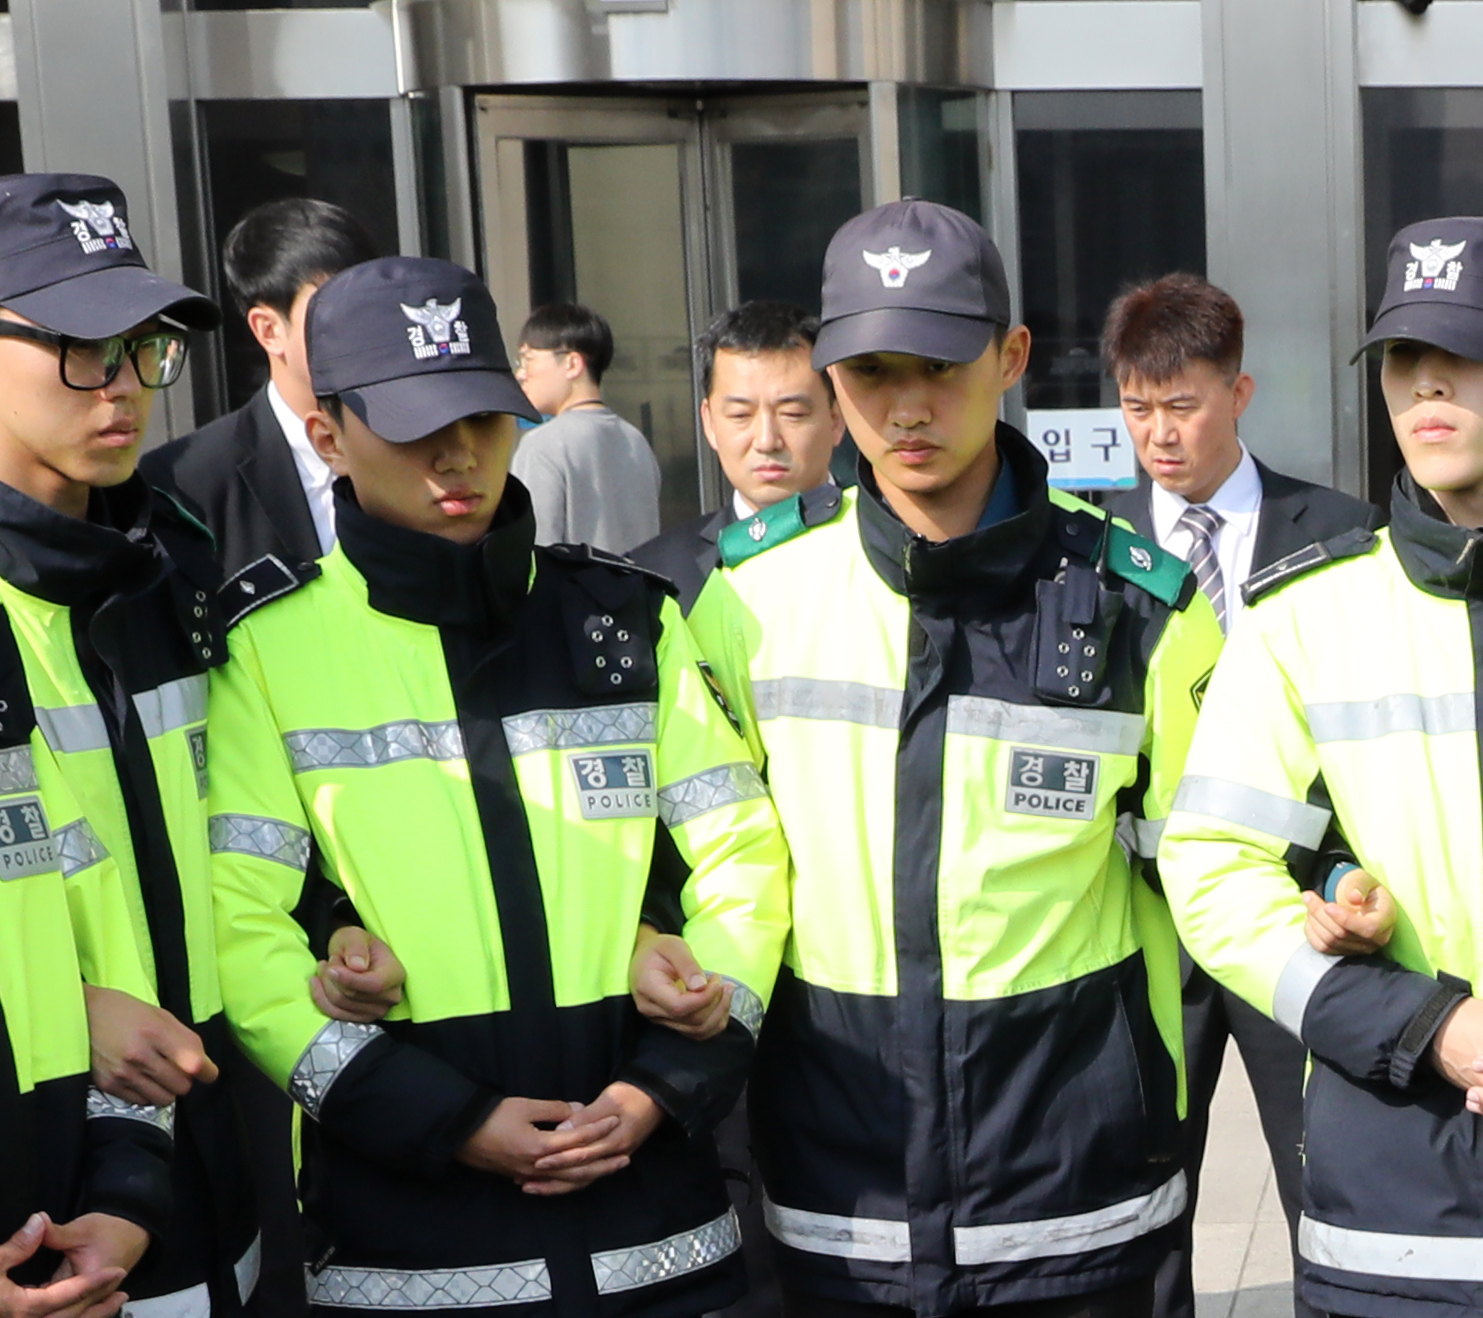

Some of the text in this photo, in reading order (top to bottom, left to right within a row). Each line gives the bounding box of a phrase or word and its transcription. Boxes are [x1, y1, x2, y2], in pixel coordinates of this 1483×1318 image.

[588, 793, 651, 810] POLICE
[1014, 792, 1086, 812] POLICE
[3, 846, 54, 870] POLICE
